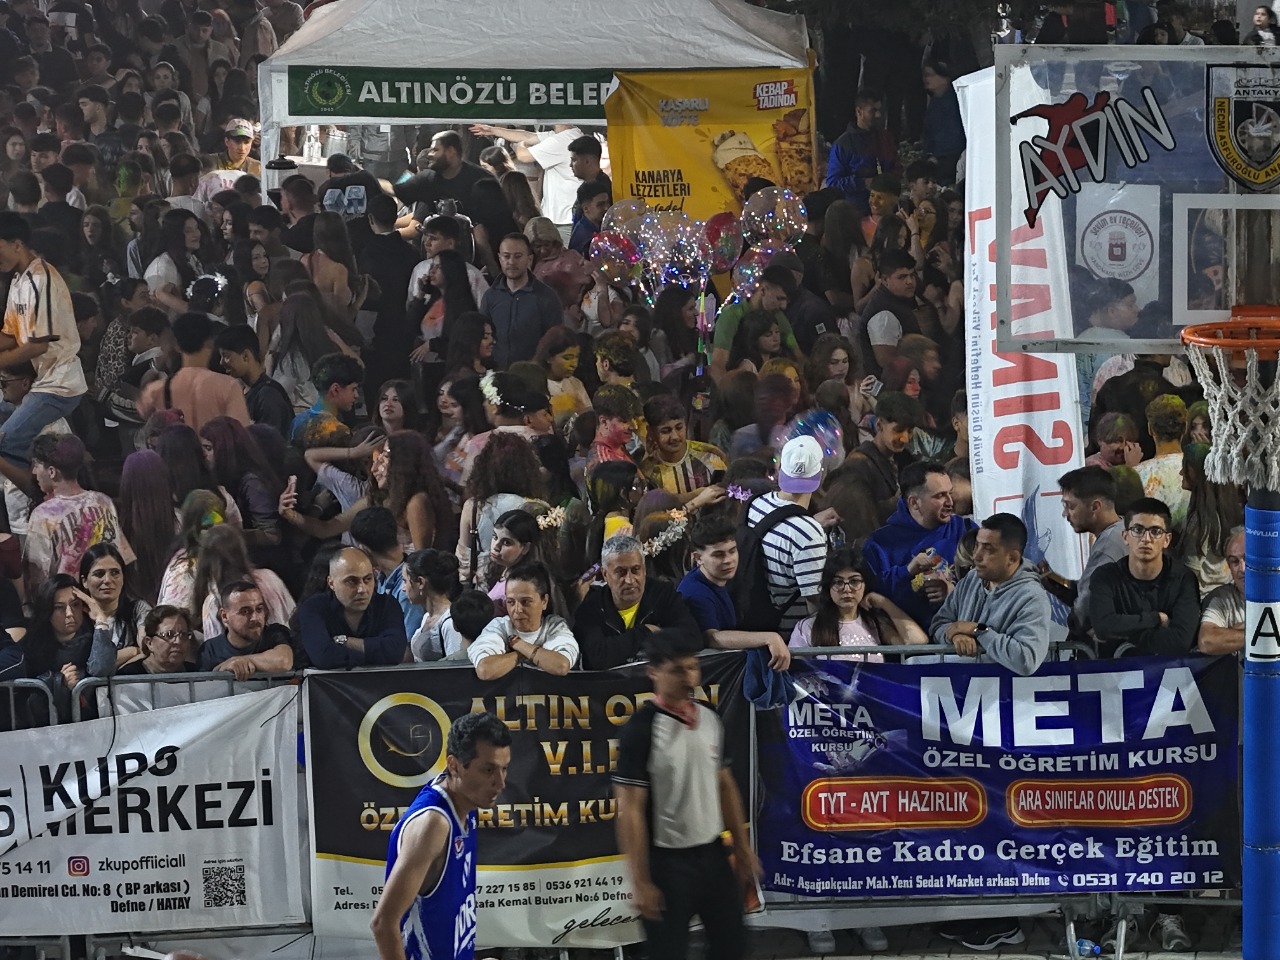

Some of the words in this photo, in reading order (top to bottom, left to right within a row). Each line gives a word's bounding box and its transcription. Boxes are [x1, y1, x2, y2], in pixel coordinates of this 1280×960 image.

[357, 75, 518, 107] ALTINÖZÜ
[756, 82, 788, 98] KEBAP
[758, 93, 796, 109] TADINDA
[1018, 85, 1177, 209] AYDIN
[634, 168, 684, 184] KANARYA
[788, 702, 875, 728] META
[919, 667, 1216, 748] META
[789, 727, 819, 739] ÖZEL
[811, 742, 854, 753] KURSU
[922, 745, 991, 769] ÖZEL
[998, 751, 1119, 773] ÖĞRETİM
[1127, 743, 1217, 770] KURSU
[818, 791, 846, 817] TYT
[860, 789, 889, 814] AYT
[897, 788, 969, 814] HAZIRLIK
[1018, 790, 1043, 812] ARA
[1044, 788, 1096, 811] SINIFLAR
[1097, 788, 1137, 811] OKULA
[1138, 786, 1180, 811] DESTEK
[780, 840, 883, 866] Efsane
[892, 839, 986, 863] Kadro
[995, 837, 1106, 866] Gerçek
[1114, 835, 1221, 864] Eğitim
[14, 860, 33, 875] 14
[37, 860, 51, 874] 11
[11, 883, 59, 898] Demirel
[61, 883, 81, 898] Cd.
[82, 883, 102, 897] No:
[103, 882, 111, 897] 8
[125, 881, 141, 895] BP
[143, 880, 182, 895] arkası
[333, 886, 354, 897] Tel.
[485, 884, 505, 895] 227
[507, 883, 521, 894] 15
[523, 882, 536, 893] 85
[545, 879, 572, 892] 0536
[574, 878, 592, 890] 921
[595, 877, 610, 888] 44
[611, 876, 624, 888] 19
[773, 872, 796, 888] Adr:
[915, 874, 944, 889] Sedat
[946, 874, 984, 888] Market
[986, 872, 1019, 887] arkası
[1021, 872, 1051, 887] Defne
[1072, 872, 1118, 887] 0531
[1124, 871, 1164, 886] 740
[1170, 871, 1196, 885] 20
[1202, 870, 1224, 884] 12
[110, 899, 146, 913] Defne
[156, 896, 191, 911] HATAY
[333, 901, 370, 912] Adres:
[498, 897, 533, 909] Kemal
[535, 894, 573, 907] Bulvarı
[575, 891, 600, 903] No:6
[602, 890, 634, 902] Defne
